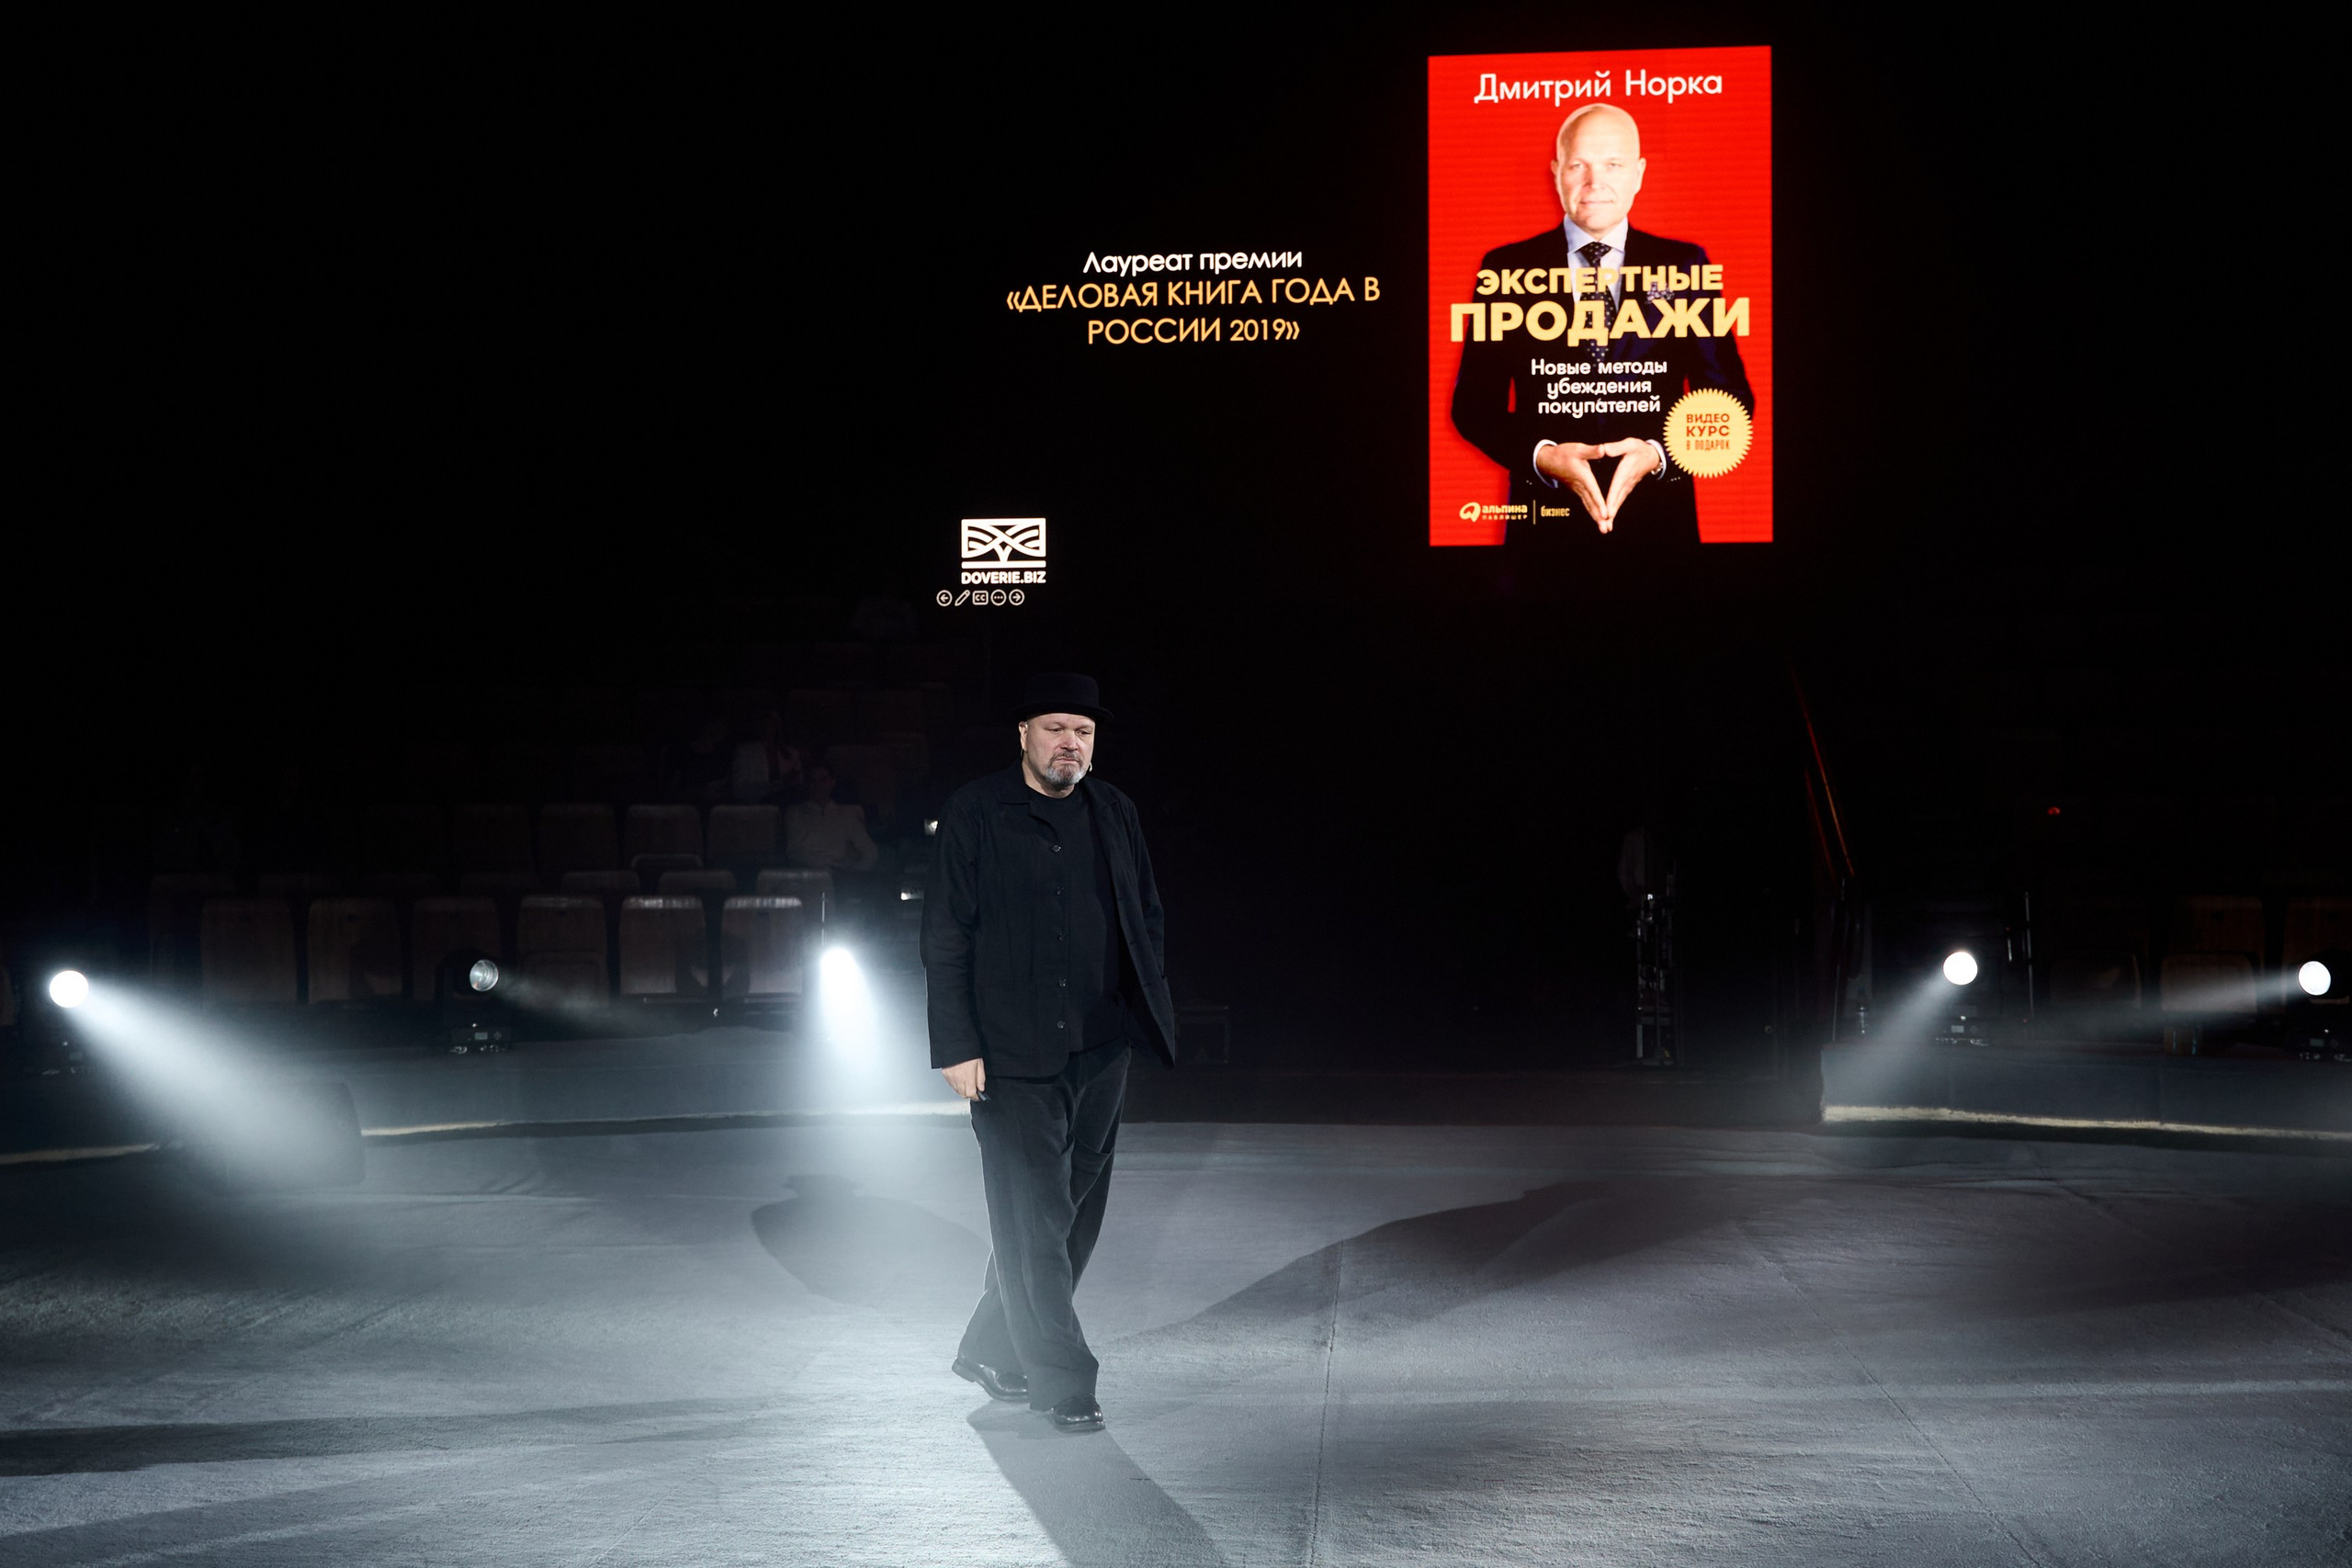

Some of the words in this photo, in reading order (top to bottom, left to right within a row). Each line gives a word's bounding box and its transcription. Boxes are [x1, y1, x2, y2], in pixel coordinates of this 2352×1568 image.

[1474, 70, 1611, 107] Дмитрий
[1625, 69, 1724, 104] Норка
[1082, 251, 1193, 277] Лауреат
[1199, 251, 1303, 275] премии
[1476, 264, 1724, 296] ЭКСПЕРТНЫЕ
[1006, 281, 1159, 313] «ДЕЛОВАЯ
[1168, 279, 1263, 306] КНИГА
[1272, 277, 1355, 306] ГОДА
[1364, 276, 1381, 301] В
[1087, 317, 1220, 345] РОССИИ
[1229, 319, 1300, 343] 2019»
[1450, 297, 1750, 348] ПРОДАЖИ
[1531, 358, 1591, 376] Новые
[1599, 357, 1668, 376] методы
[1546, 378, 1652, 400] убеждения
[1538, 395, 1661, 419] покупателей
[1686, 413, 1730, 424] ВИДЕО
[1686, 425, 1730, 437] КУРС
[1685, 439, 1691, 450] В
[1694, 438, 1731, 451] ПОДАРОК
[1482, 503, 1528, 514] альпина
[1540, 505, 1571, 518] бизнес
[961, 571, 1046, 584] DOVERIE.BIZ
